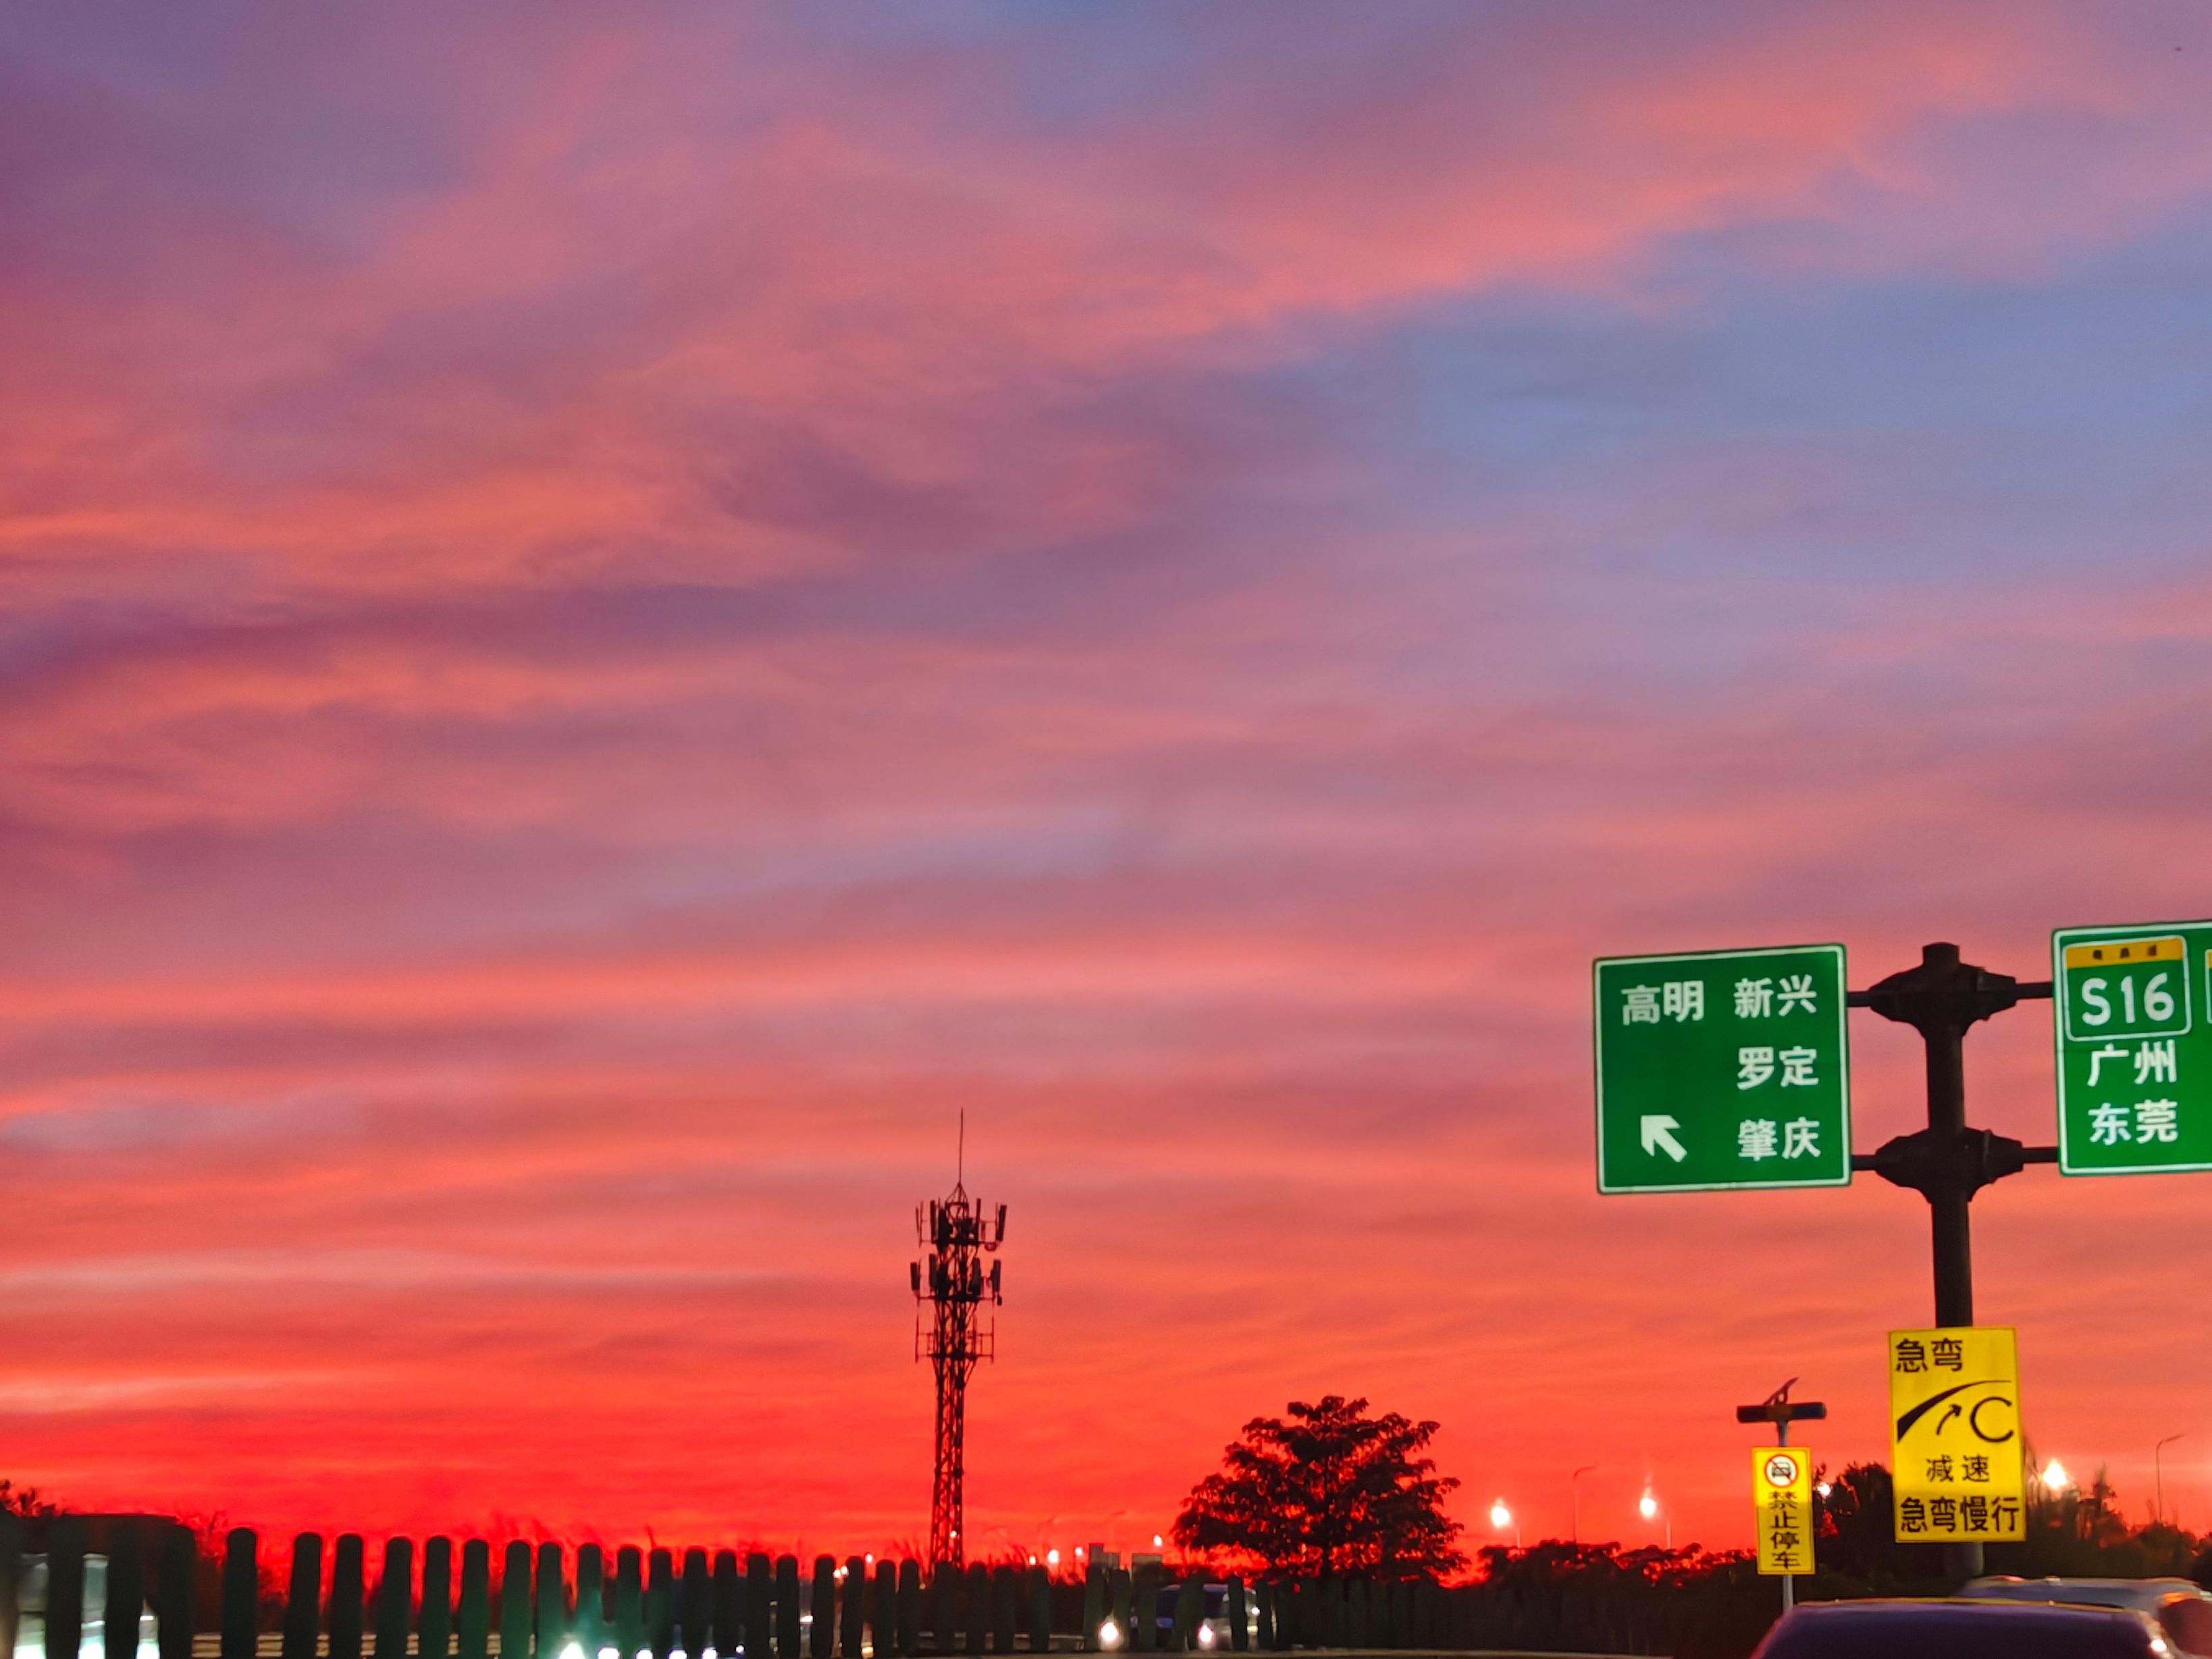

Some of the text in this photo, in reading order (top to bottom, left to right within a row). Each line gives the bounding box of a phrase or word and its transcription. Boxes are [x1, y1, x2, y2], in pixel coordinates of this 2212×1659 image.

[1621, 974, 1817, 1025] 高明 新兴
[2082, 973, 2174, 1026] S16
[1737, 1046, 1819, 1090] 罗定
[2087, 1039, 2178, 1087] 广州
[1738, 1117, 1821, 1161] 肇庆
[2088, 1099, 2178, 1145] 东莞
[1895, 1338, 1964, 1373] 急弯
[1926, 1454, 1990, 1482] 减速
[1768, 1491, 1801, 1569] 禁止停车
[1901, 1496, 2020, 1533] 急弯慢行
